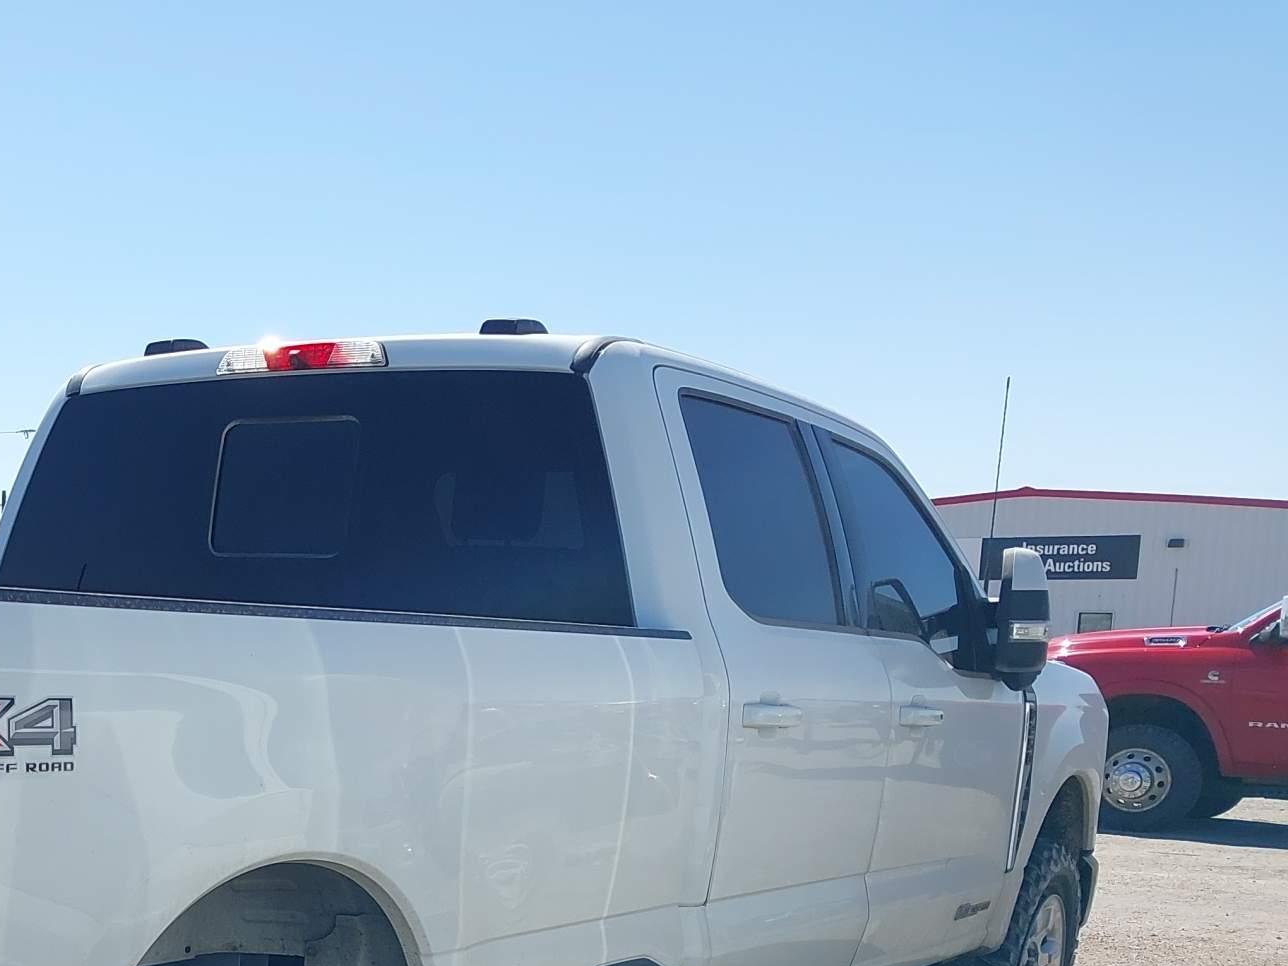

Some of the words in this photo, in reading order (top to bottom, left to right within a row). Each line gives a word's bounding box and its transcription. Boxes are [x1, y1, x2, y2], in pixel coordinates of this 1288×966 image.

[1022, 541, 1097, 555] Insurance
[1045, 558, 1111, 572] Auctions
[25, 761, 74, 773] ROAD
